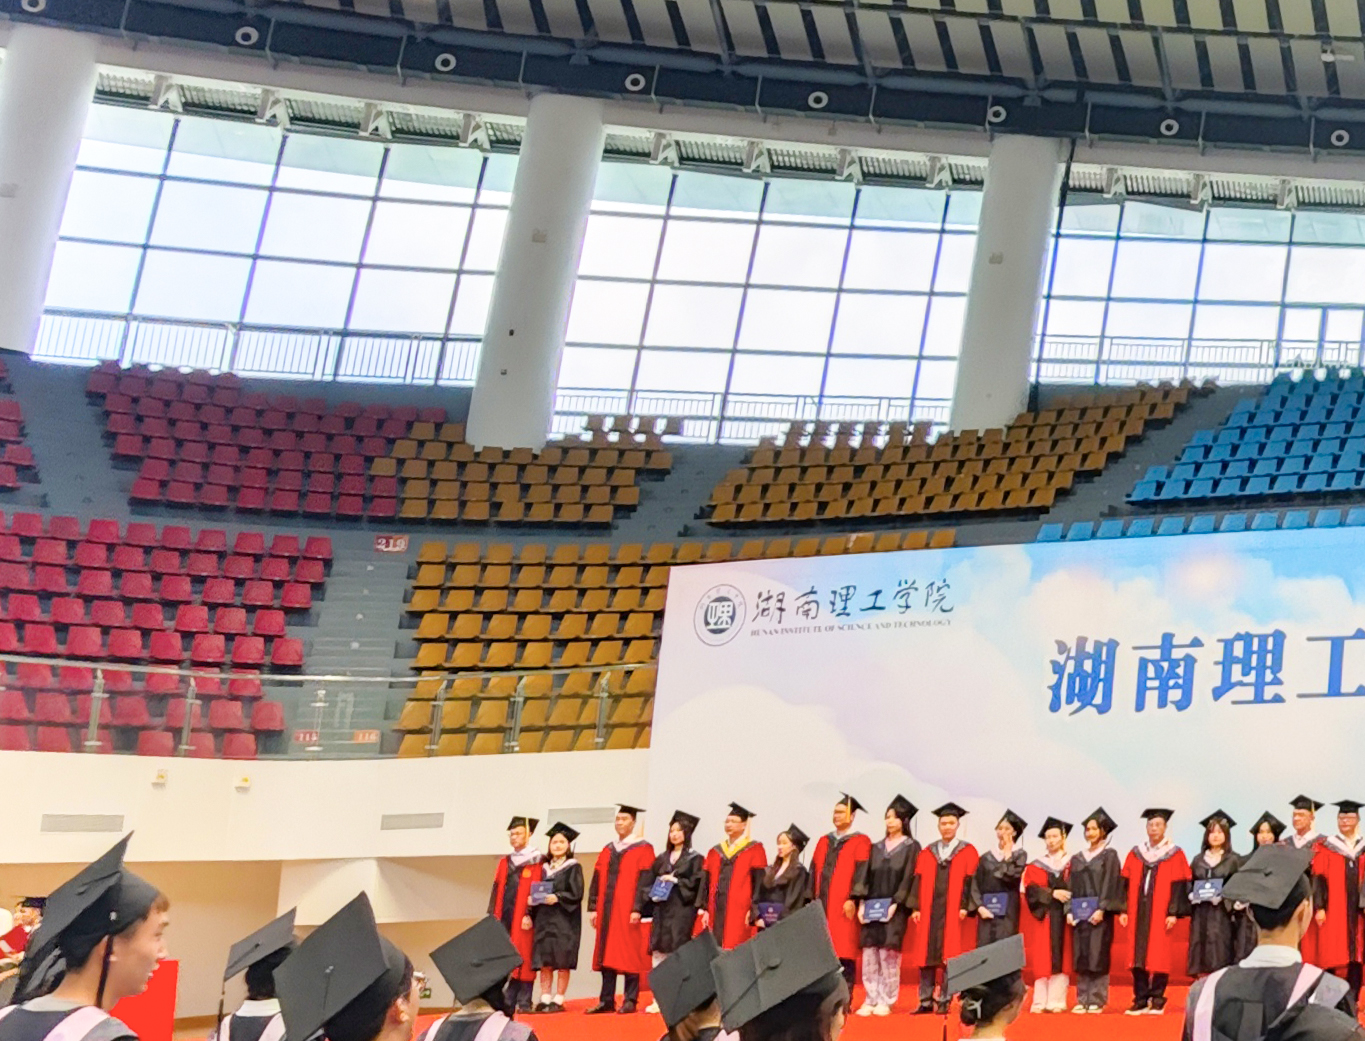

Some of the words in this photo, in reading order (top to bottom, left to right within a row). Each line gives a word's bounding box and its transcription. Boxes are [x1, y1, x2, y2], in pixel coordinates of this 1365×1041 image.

[752, 577, 954, 624] 湖南理工学院
